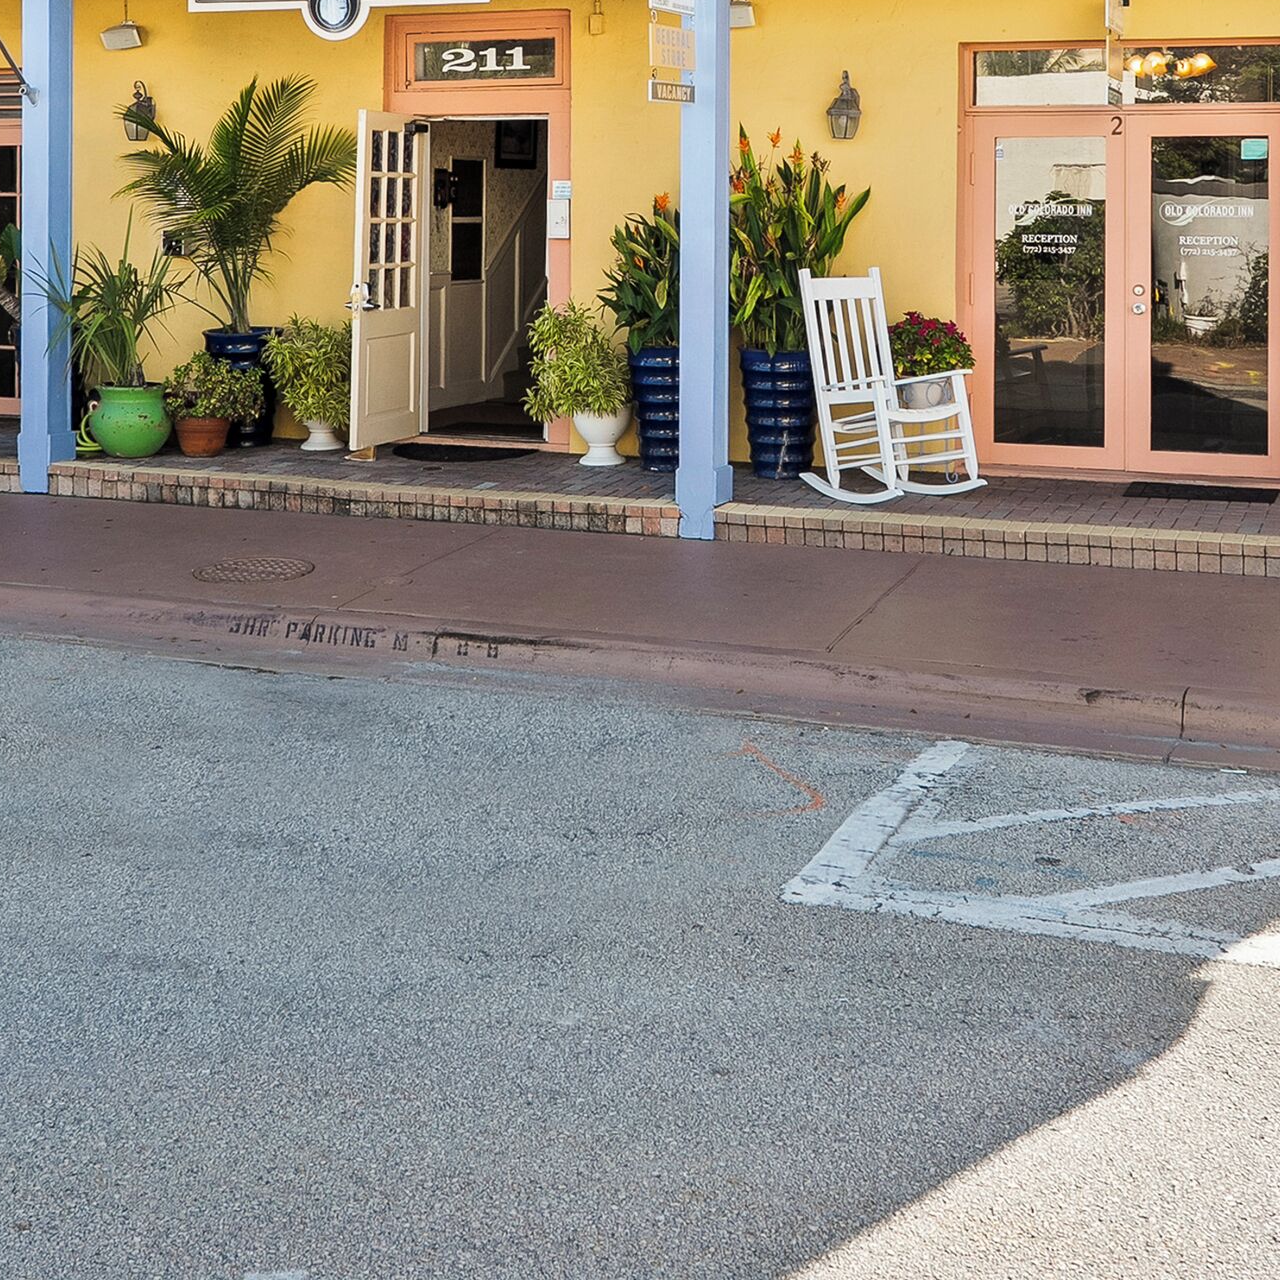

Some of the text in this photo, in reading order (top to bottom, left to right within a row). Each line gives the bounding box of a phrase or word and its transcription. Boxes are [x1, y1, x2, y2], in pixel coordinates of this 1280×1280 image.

[655, 27, 691, 49] GENERAL
[441, 46, 531, 73] 211
[661, 48, 687, 67] STORE
[656, 84, 692, 101] VACANCY
[1110, 116, 1123, 136] 2
[1076, 203, 1093, 217] INN
[1164, 204, 1254, 217] OLD COLORADO INN
[1021, 234, 1078, 244] RECEPTION
[1179, 235, 1239, 246] RECEPTION
[1022, 245, 1077, 255] (772) 215-3437
[1180, 247, 1201, 257] (772)
[284, 621, 377, 649] PARKING
